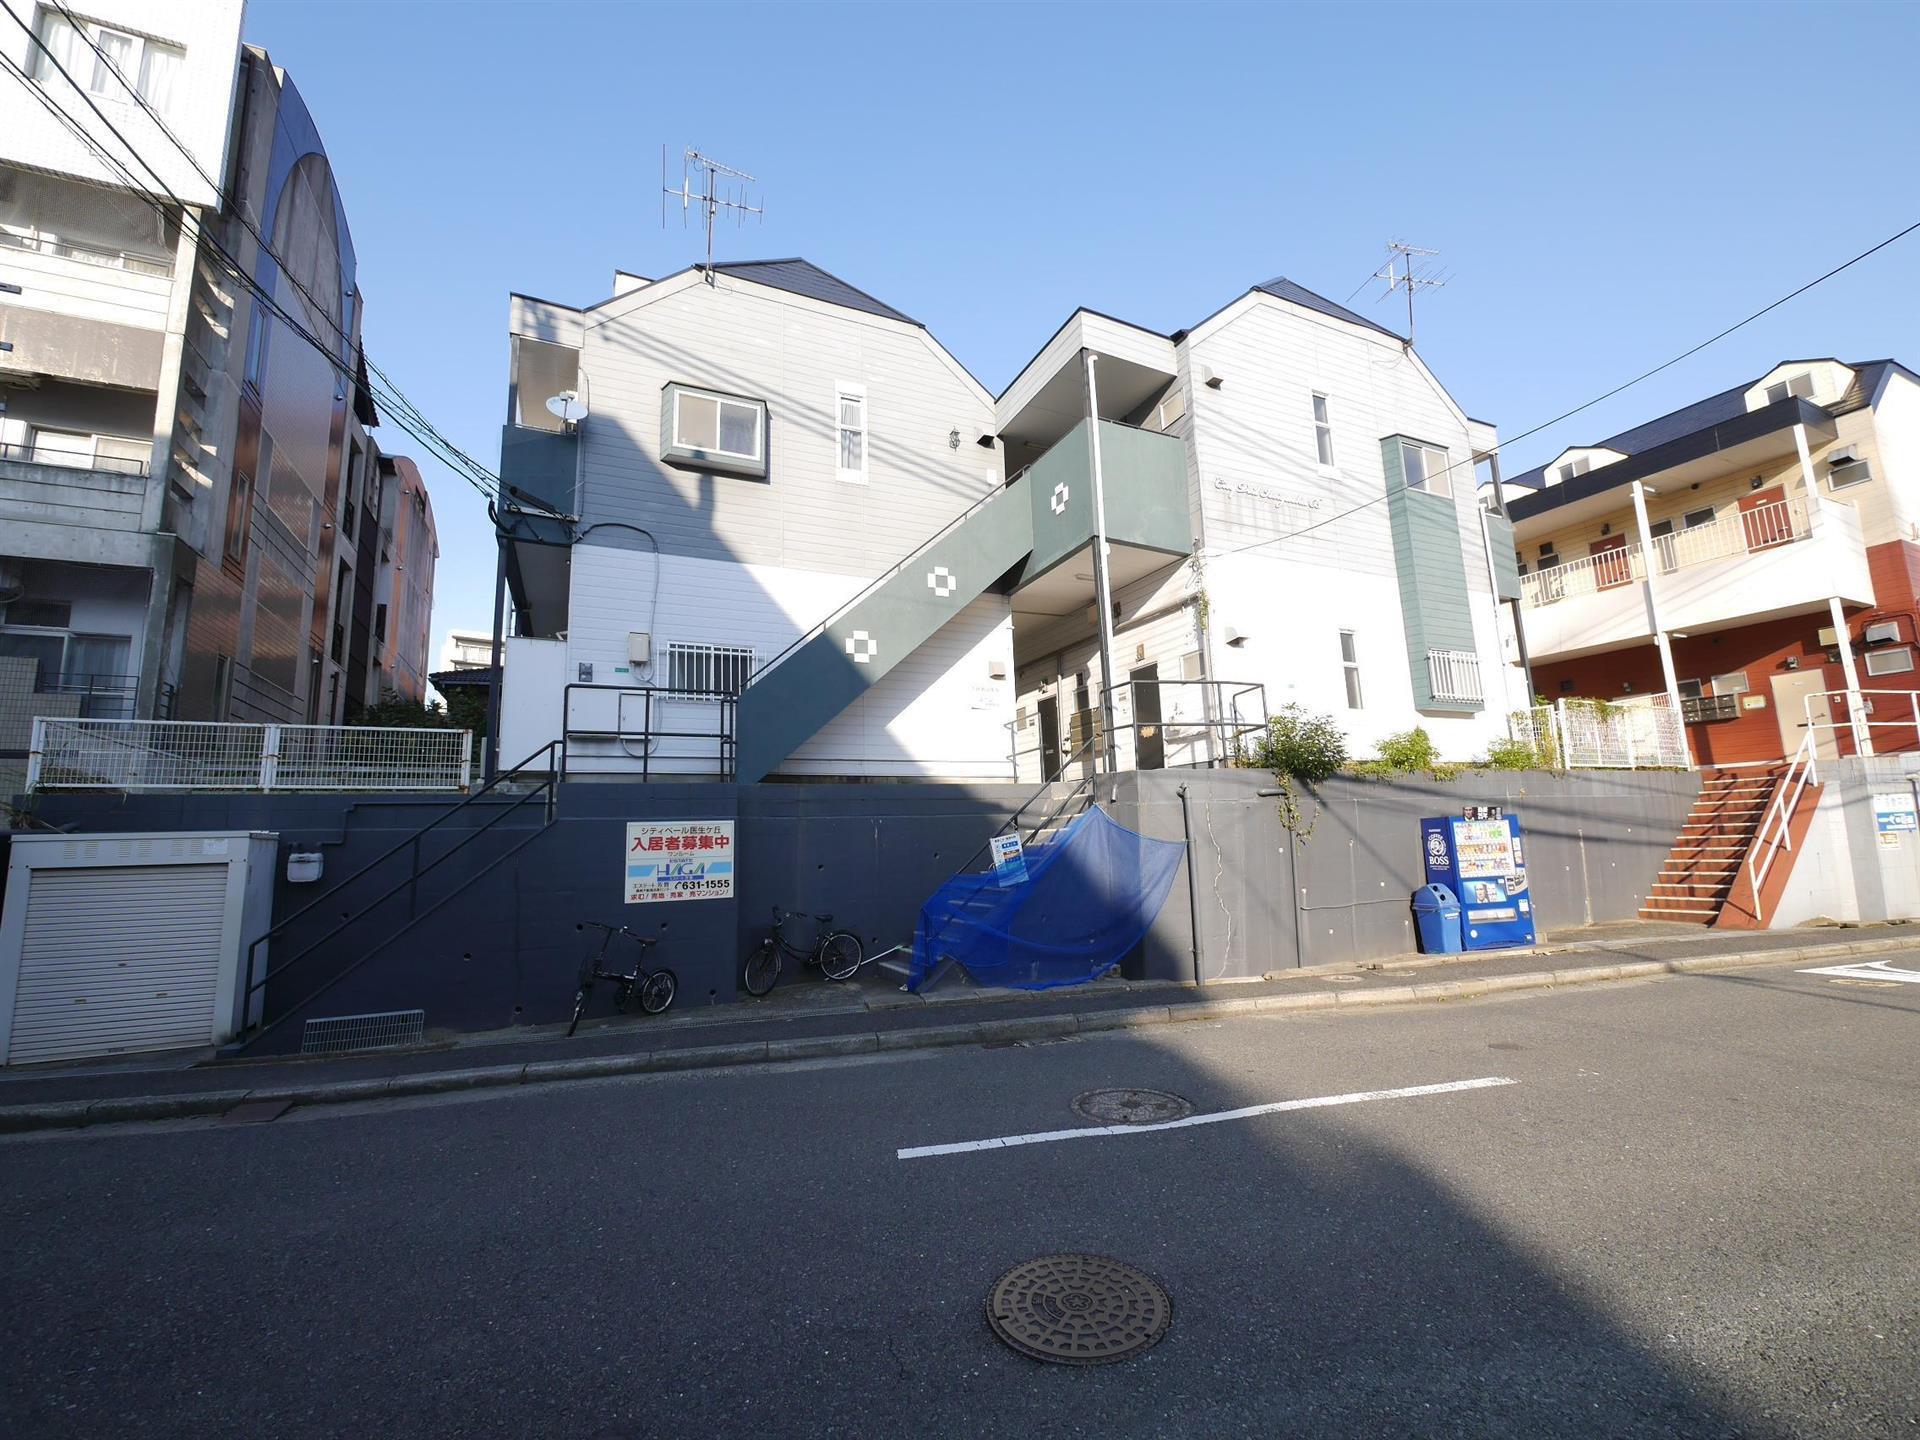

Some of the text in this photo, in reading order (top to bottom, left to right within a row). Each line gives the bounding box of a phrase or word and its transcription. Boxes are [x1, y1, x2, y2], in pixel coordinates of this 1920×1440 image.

[631, 835, 730, 851] 入居者募集中
[1429, 856, 1449, 865] BOSS
[656, 862, 705, 875] HAGA
[682, 880, 730, 890] 631-1555
